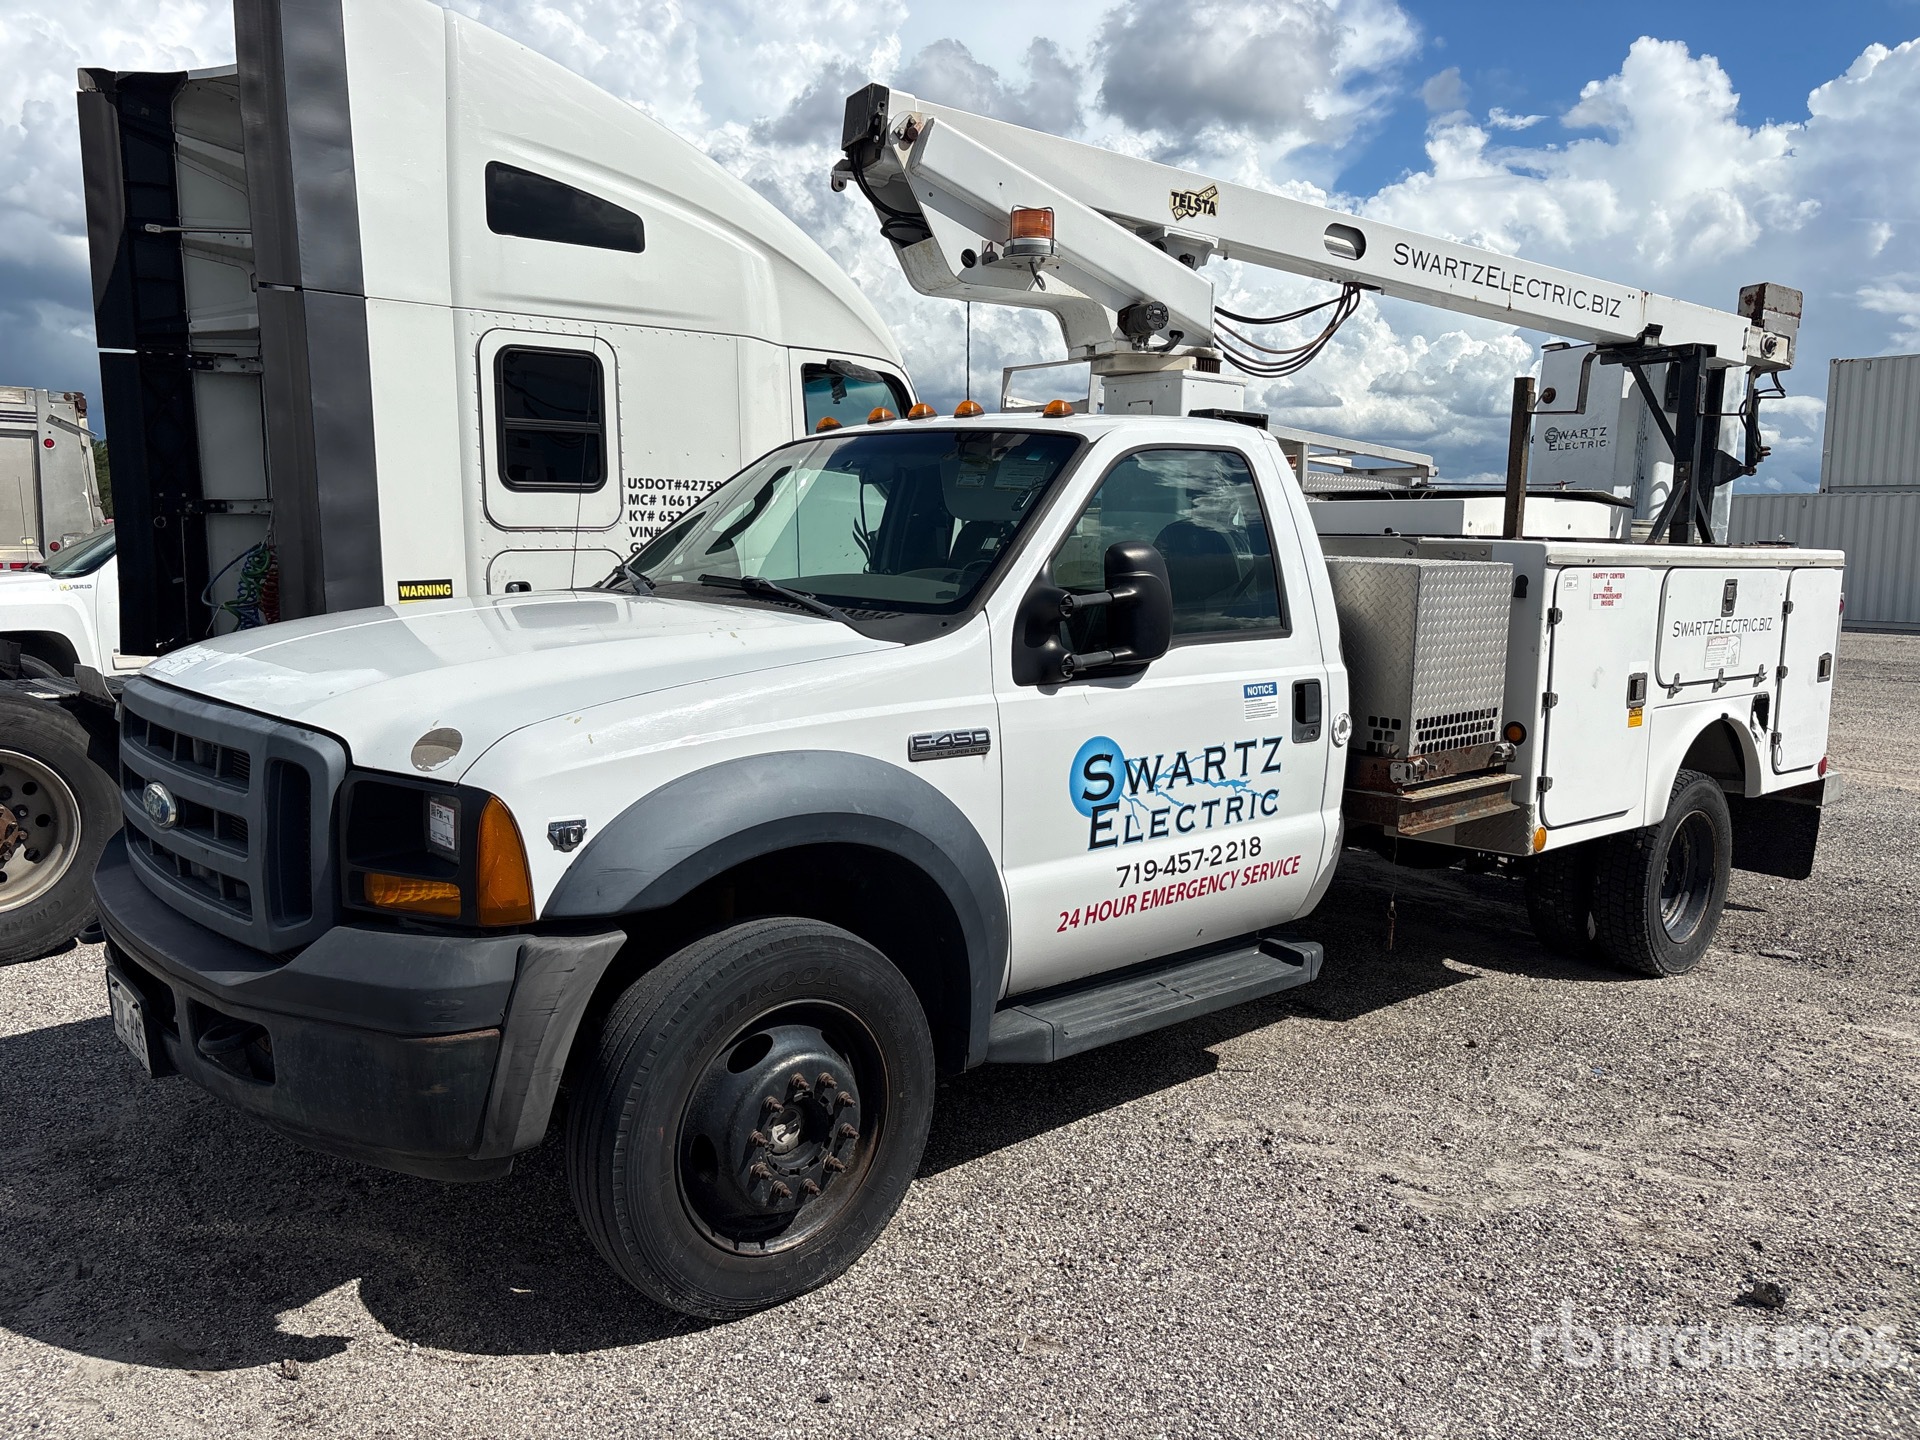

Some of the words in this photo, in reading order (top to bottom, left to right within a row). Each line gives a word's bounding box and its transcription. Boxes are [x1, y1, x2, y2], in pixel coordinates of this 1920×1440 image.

[1171, 191, 1216, 216] TELSTA
[1547, 427, 1608, 441] SWARTZ
[1549, 440, 1607, 451] ELECTRIC
[628, 494, 657, 506] MC#
[629, 510, 655, 521] KY#
[629, 526, 661, 538] VIN#
[399, 583, 451, 597] WARNING
[1247, 684, 1274, 696] NOTICE
[912, 730, 990, 751] F-450
[947, 748, 970, 756] SUPER
[1082, 736, 1284, 802] SWARTZ
[1088, 789, 1280, 851] ELECTRIC
[1116, 836, 1262, 888] 719-457-2218
[1057, 911, 1080, 933] 24
[1084, 892, 1137, 926] HOUR
[1140, 869, 1240, 912] EMERGENCY
[1241, 855, 1301, 886] SERVICE
